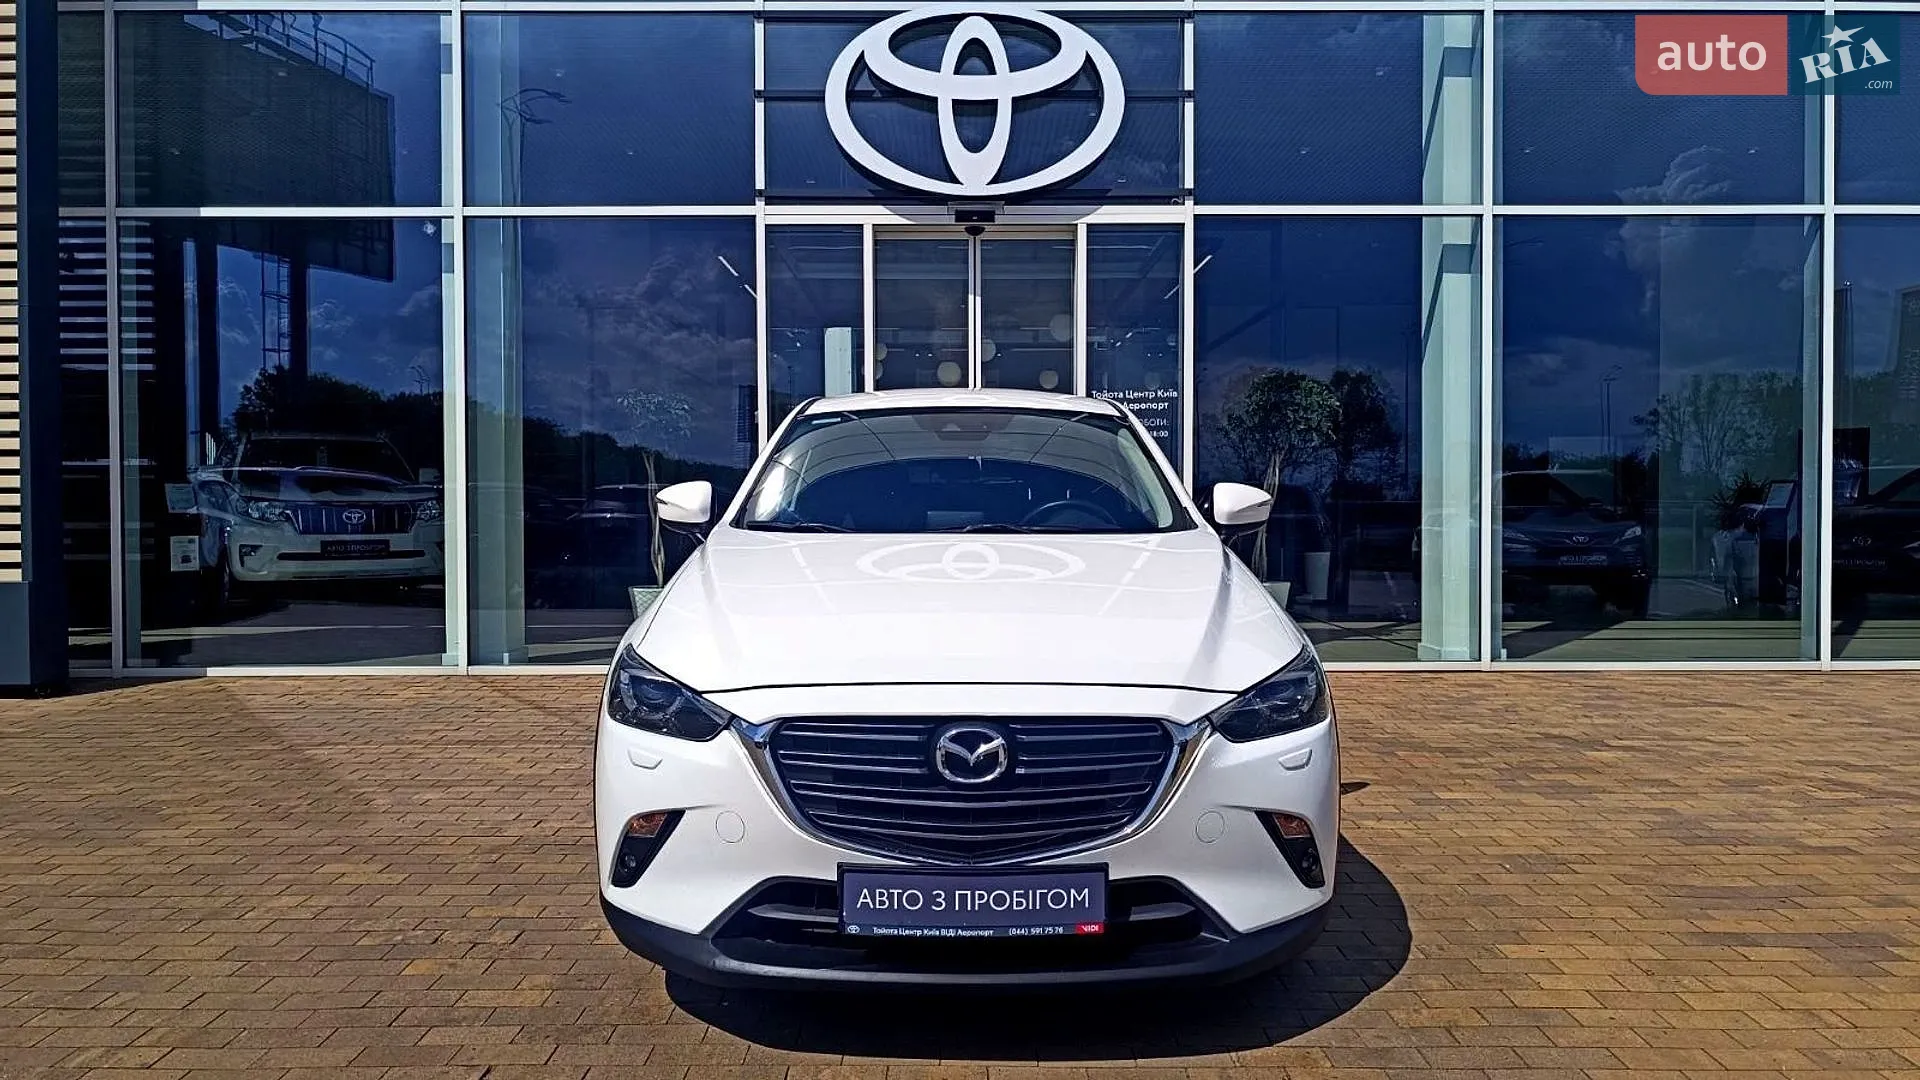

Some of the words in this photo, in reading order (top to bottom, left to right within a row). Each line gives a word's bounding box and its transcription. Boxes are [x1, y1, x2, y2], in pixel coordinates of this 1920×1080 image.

[1091, 390, 1123, 399] Тойота
[1125, 390, 1155, 399] Центр
[1157, 389, 1178, 398] Київ
[856, 888, 923, 910] АВТО
[931, 890, 946, 911] З
[954, 887, 1090, 911] ПРОБІГОМ
[899, 928, 922, 936] Центр
